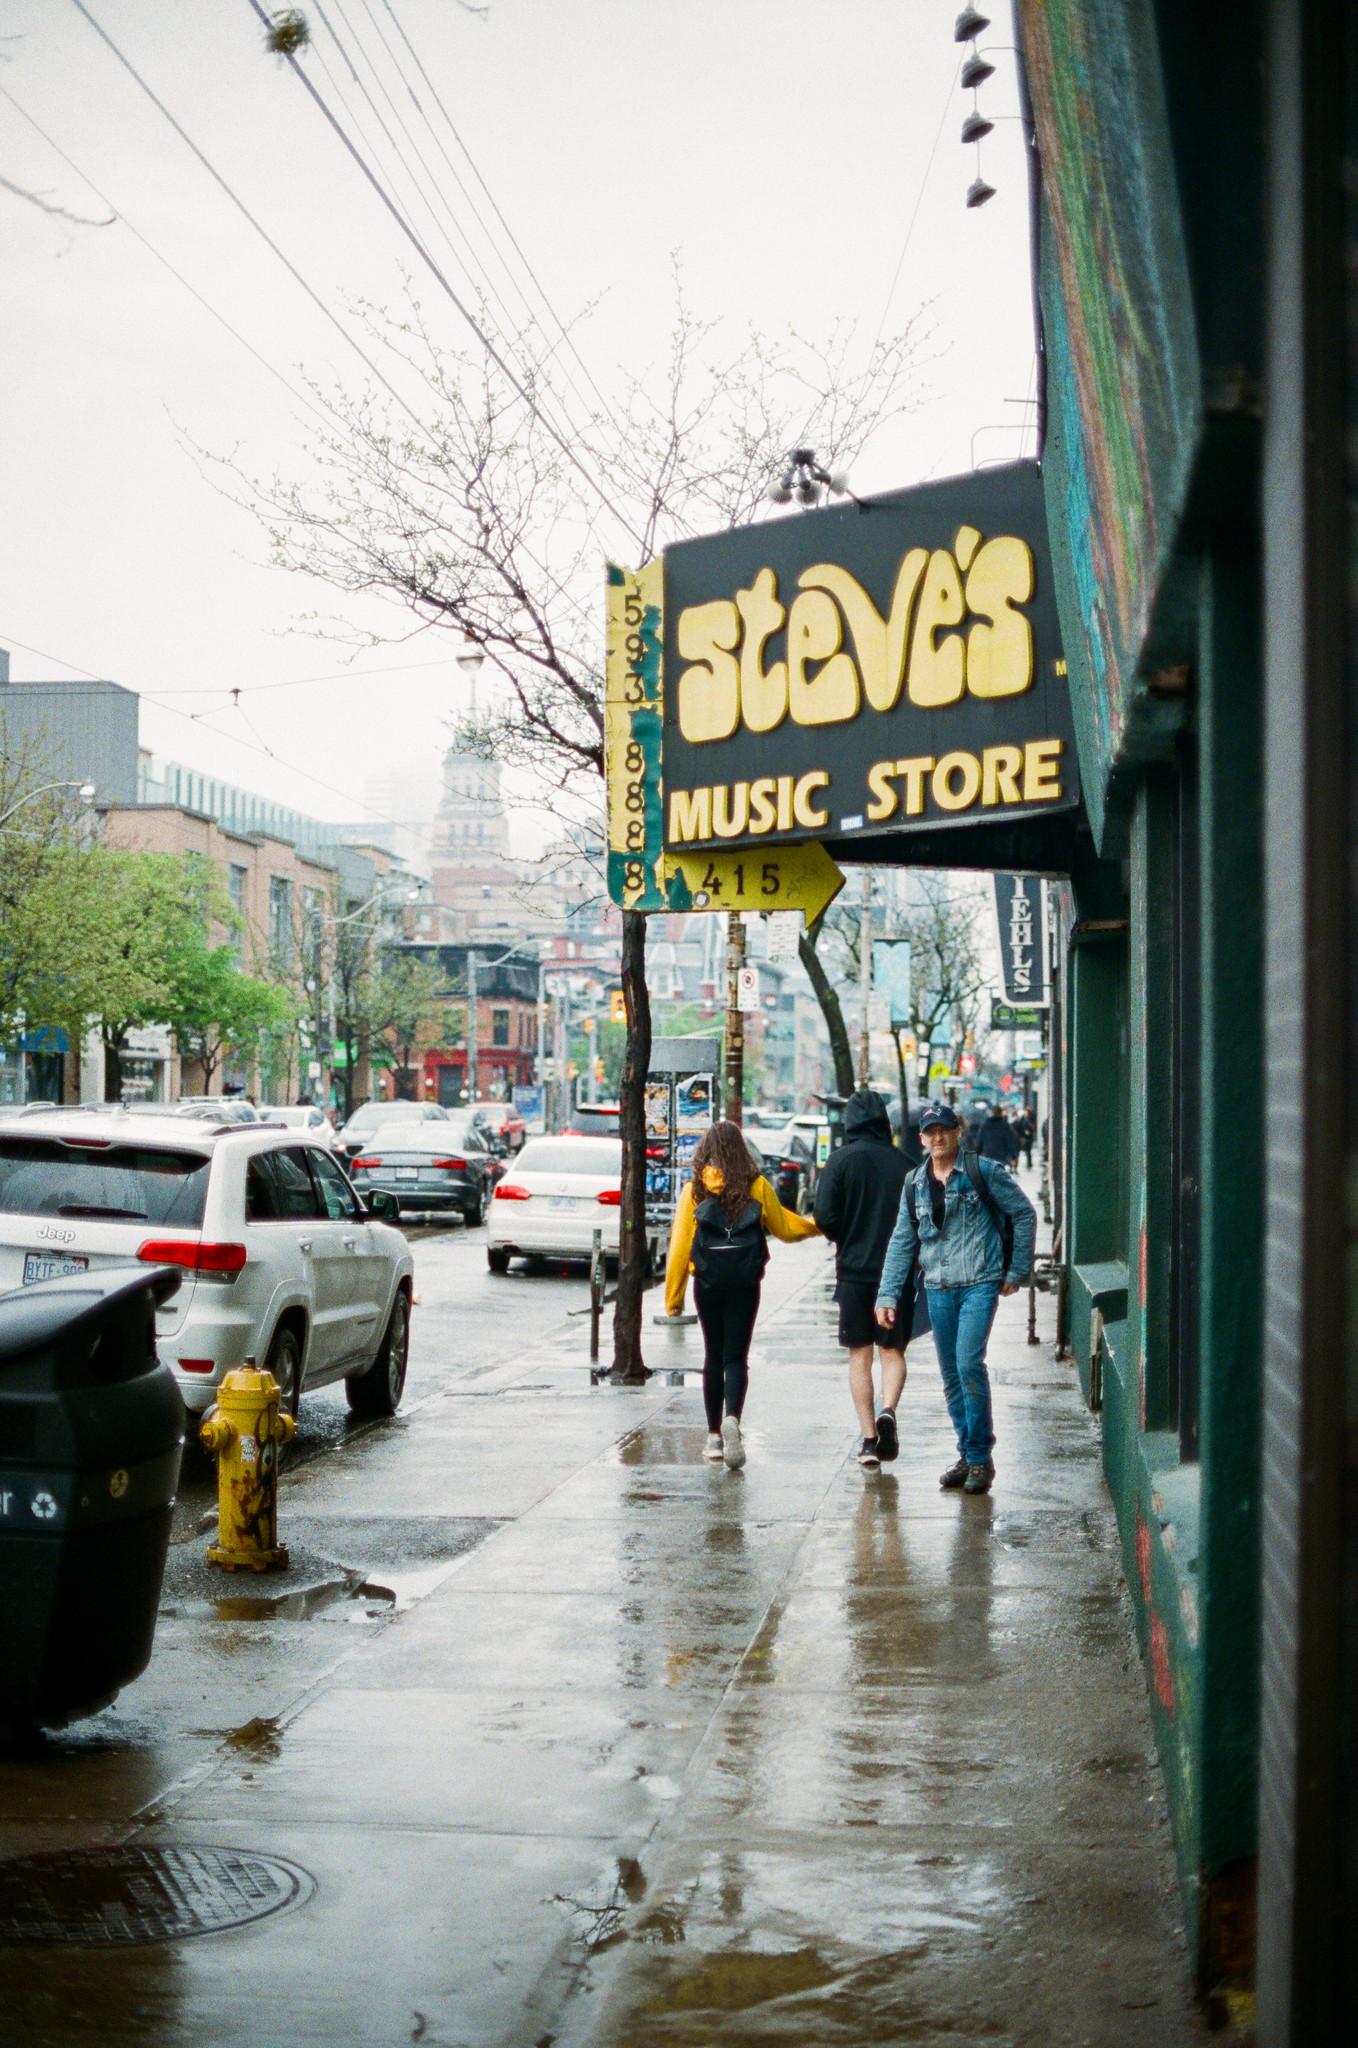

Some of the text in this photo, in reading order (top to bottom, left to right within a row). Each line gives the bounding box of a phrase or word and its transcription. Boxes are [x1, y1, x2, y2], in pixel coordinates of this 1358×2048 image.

[668, 738, 1063, 844] MUSIC STORE
[702, 862, 781, 896] 415
[36, 1226, 76, 1243] Jeep
